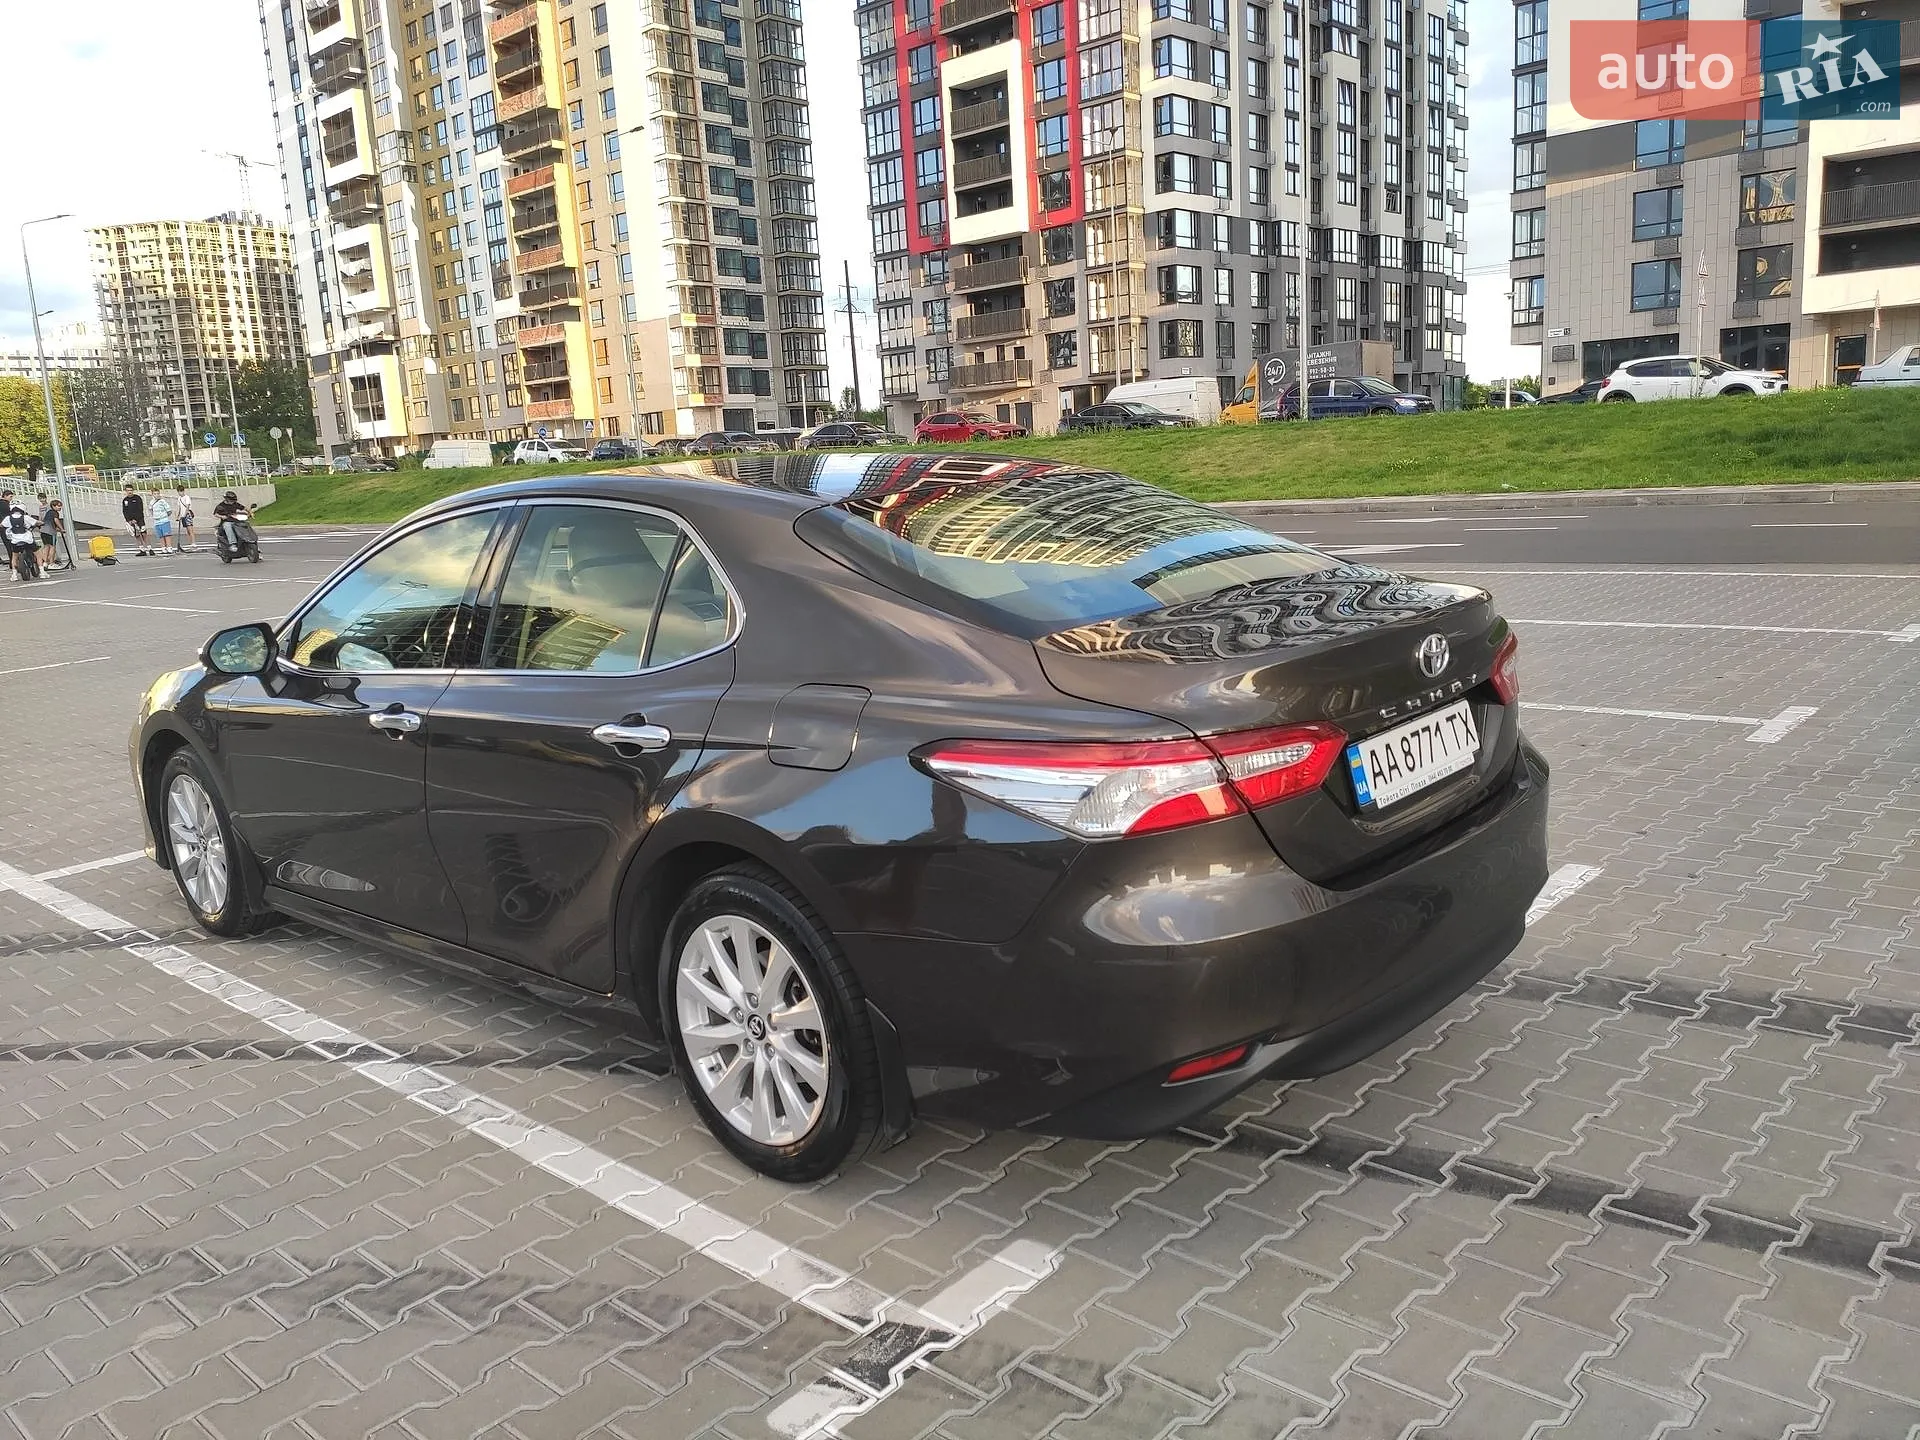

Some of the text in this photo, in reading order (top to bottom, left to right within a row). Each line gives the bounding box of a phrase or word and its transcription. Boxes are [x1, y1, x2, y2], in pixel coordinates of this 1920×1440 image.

[1306, 351, 1332, 359] АНТАЖНІ
[1267, 365, 1283, 376] 24/7
[1379, 673, 1477, 718] CAMRY
[1357, 781, 1368, 794] UA
